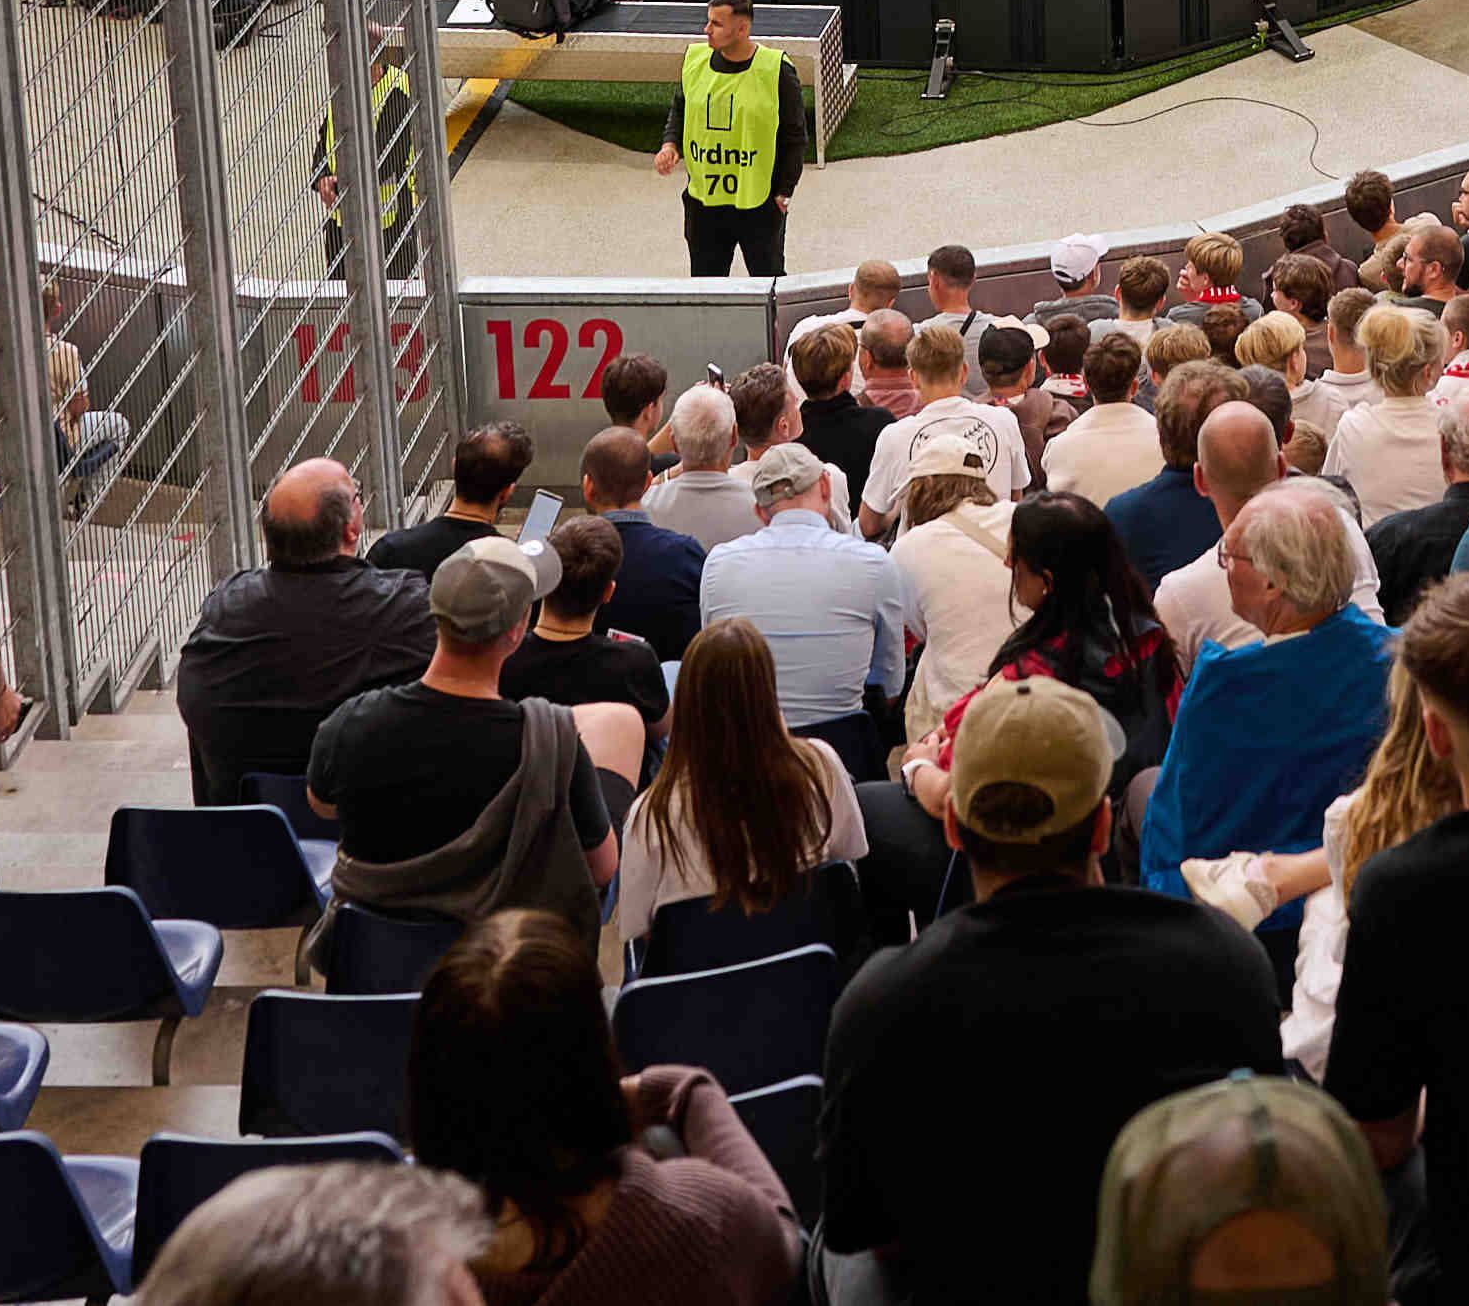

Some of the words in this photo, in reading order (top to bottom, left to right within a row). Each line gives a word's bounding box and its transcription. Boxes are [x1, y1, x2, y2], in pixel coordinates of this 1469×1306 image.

[690, 140, 757, 168] Ordner
[704, 173, 738, 196] 70
[485, 318, 624, 400] 122
